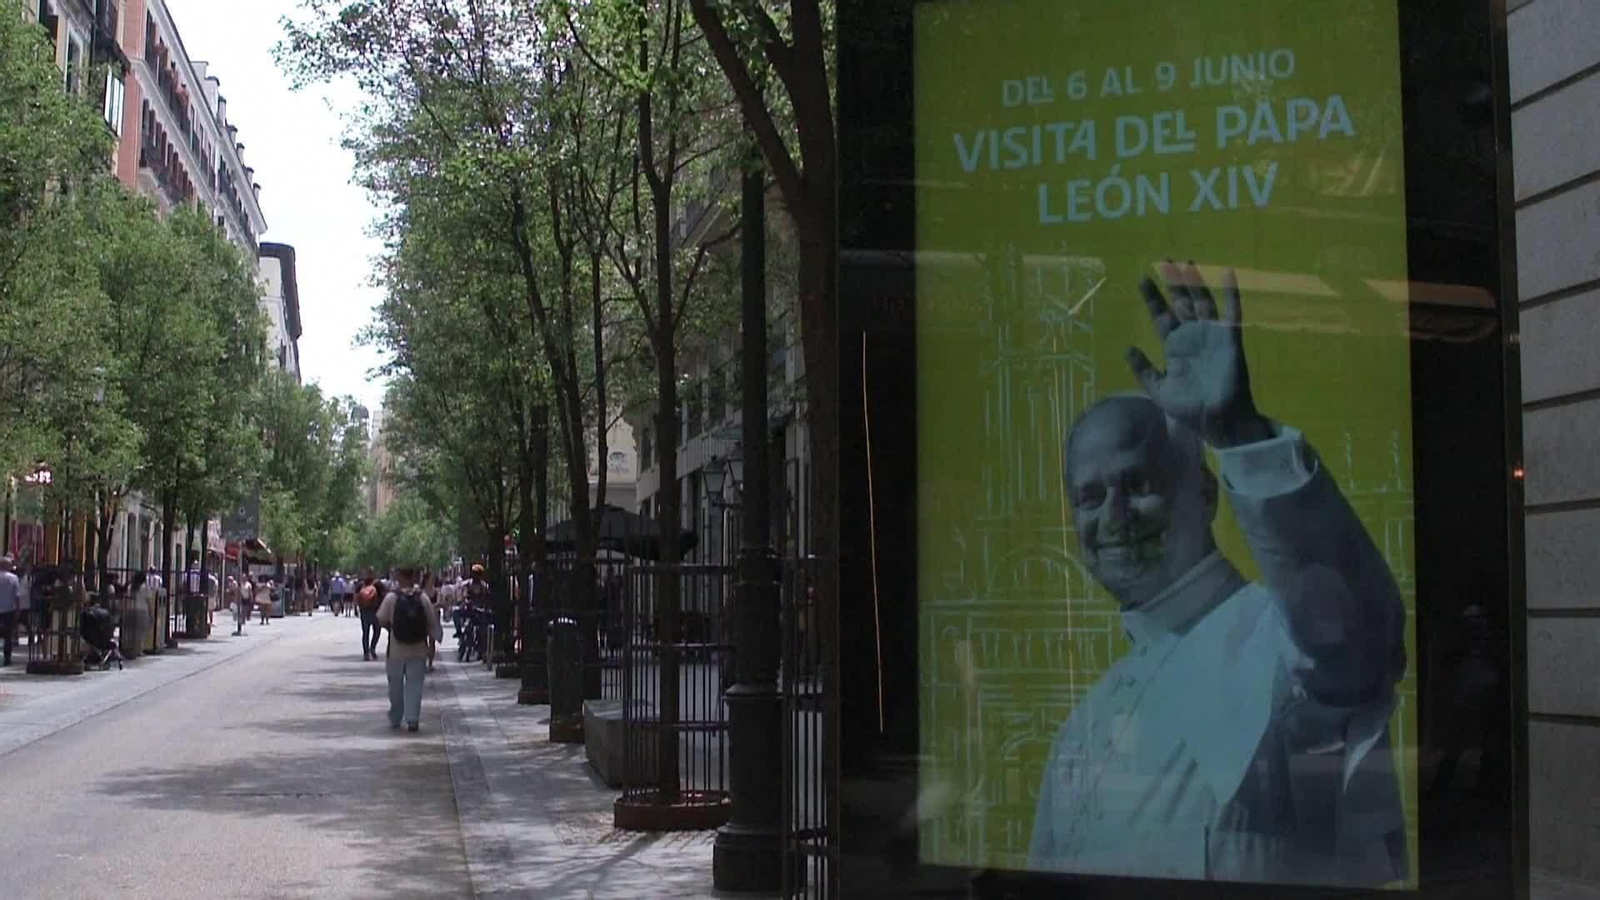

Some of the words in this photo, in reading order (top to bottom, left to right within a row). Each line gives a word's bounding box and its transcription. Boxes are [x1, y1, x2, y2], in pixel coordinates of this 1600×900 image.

[1002, 76, 1053, 107] DEL
[1067, 71, 1087, 99] 6
[1100, 67, 1140, 96] AL
[1155, 62, 1176, 90] 9
[1190, 48, 1295, 88] JUNIO
[953, 120, 1096, 172] VISITA
[1115, 110, 1195, 158] DEL
[1216, 95, 1355, 149] PAPA
[1038, 164, 1170, 224] LEÓN
[1187, 161, 1279, 213] XIV
